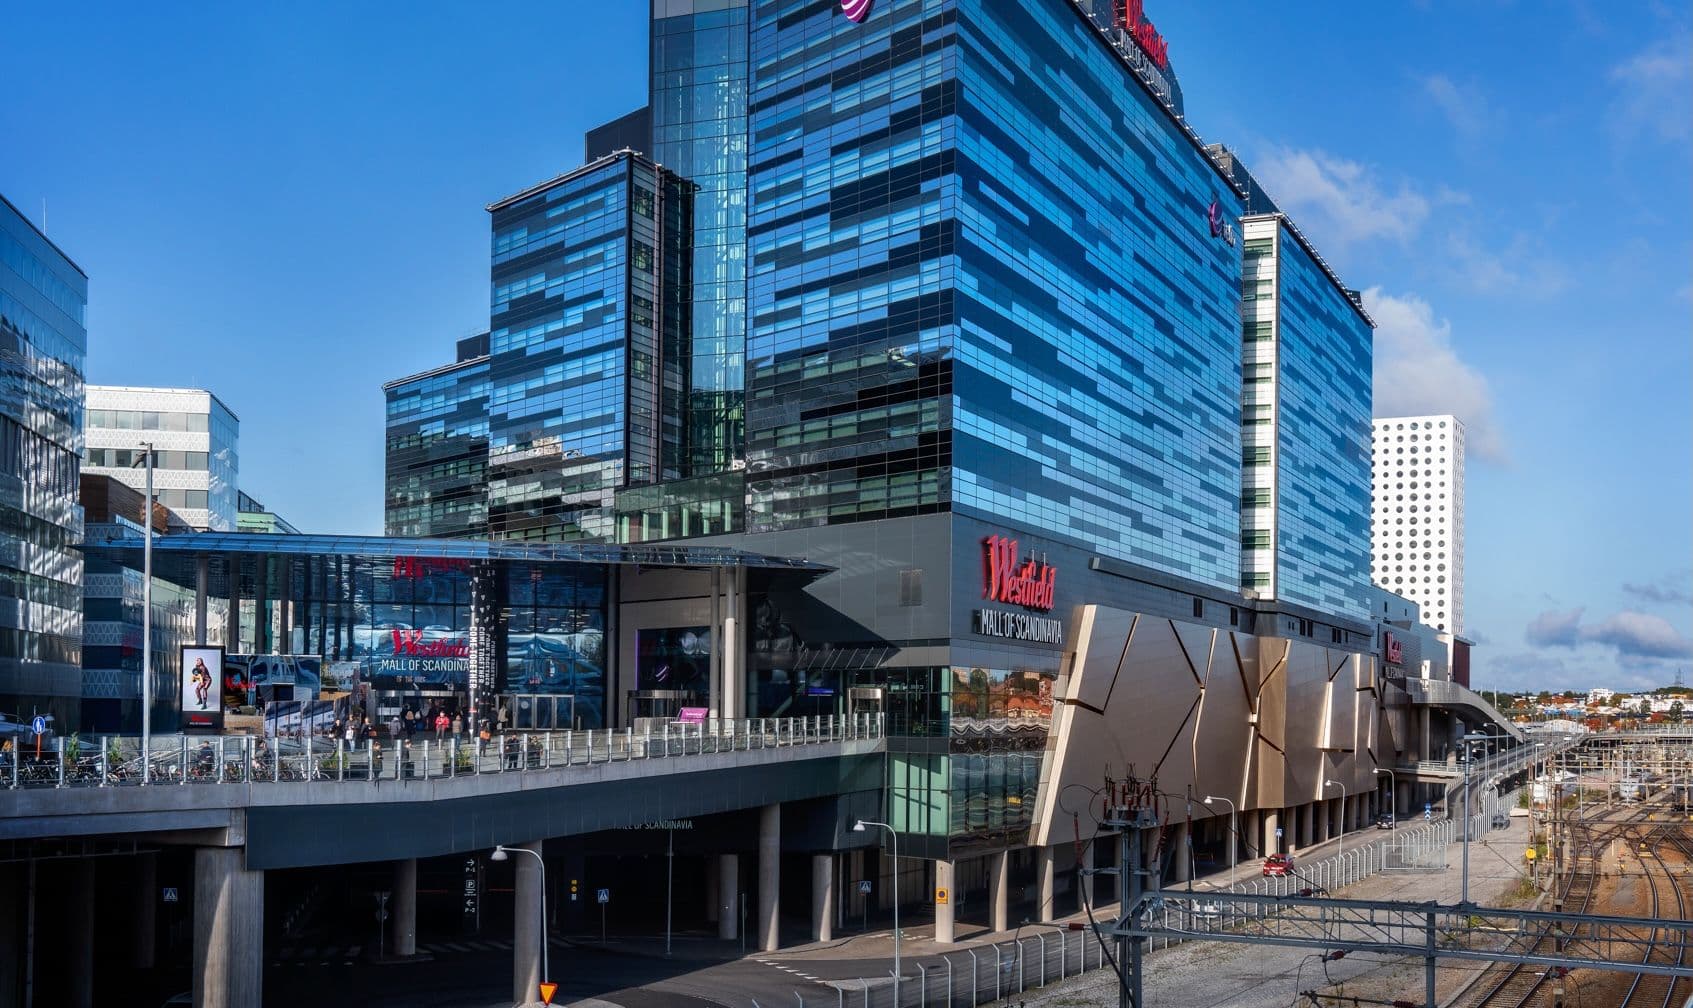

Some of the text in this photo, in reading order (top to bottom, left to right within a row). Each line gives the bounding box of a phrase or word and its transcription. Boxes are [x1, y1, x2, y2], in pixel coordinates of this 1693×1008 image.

[987, 534, 1056, 609] Westfield
[982, 608, 1062, 644] MALL OF SCANDINAVIA
[381, 659, 470, 671] MALL OF SCANDINA
[469, 626, 478, 689] COME TOGETHER
